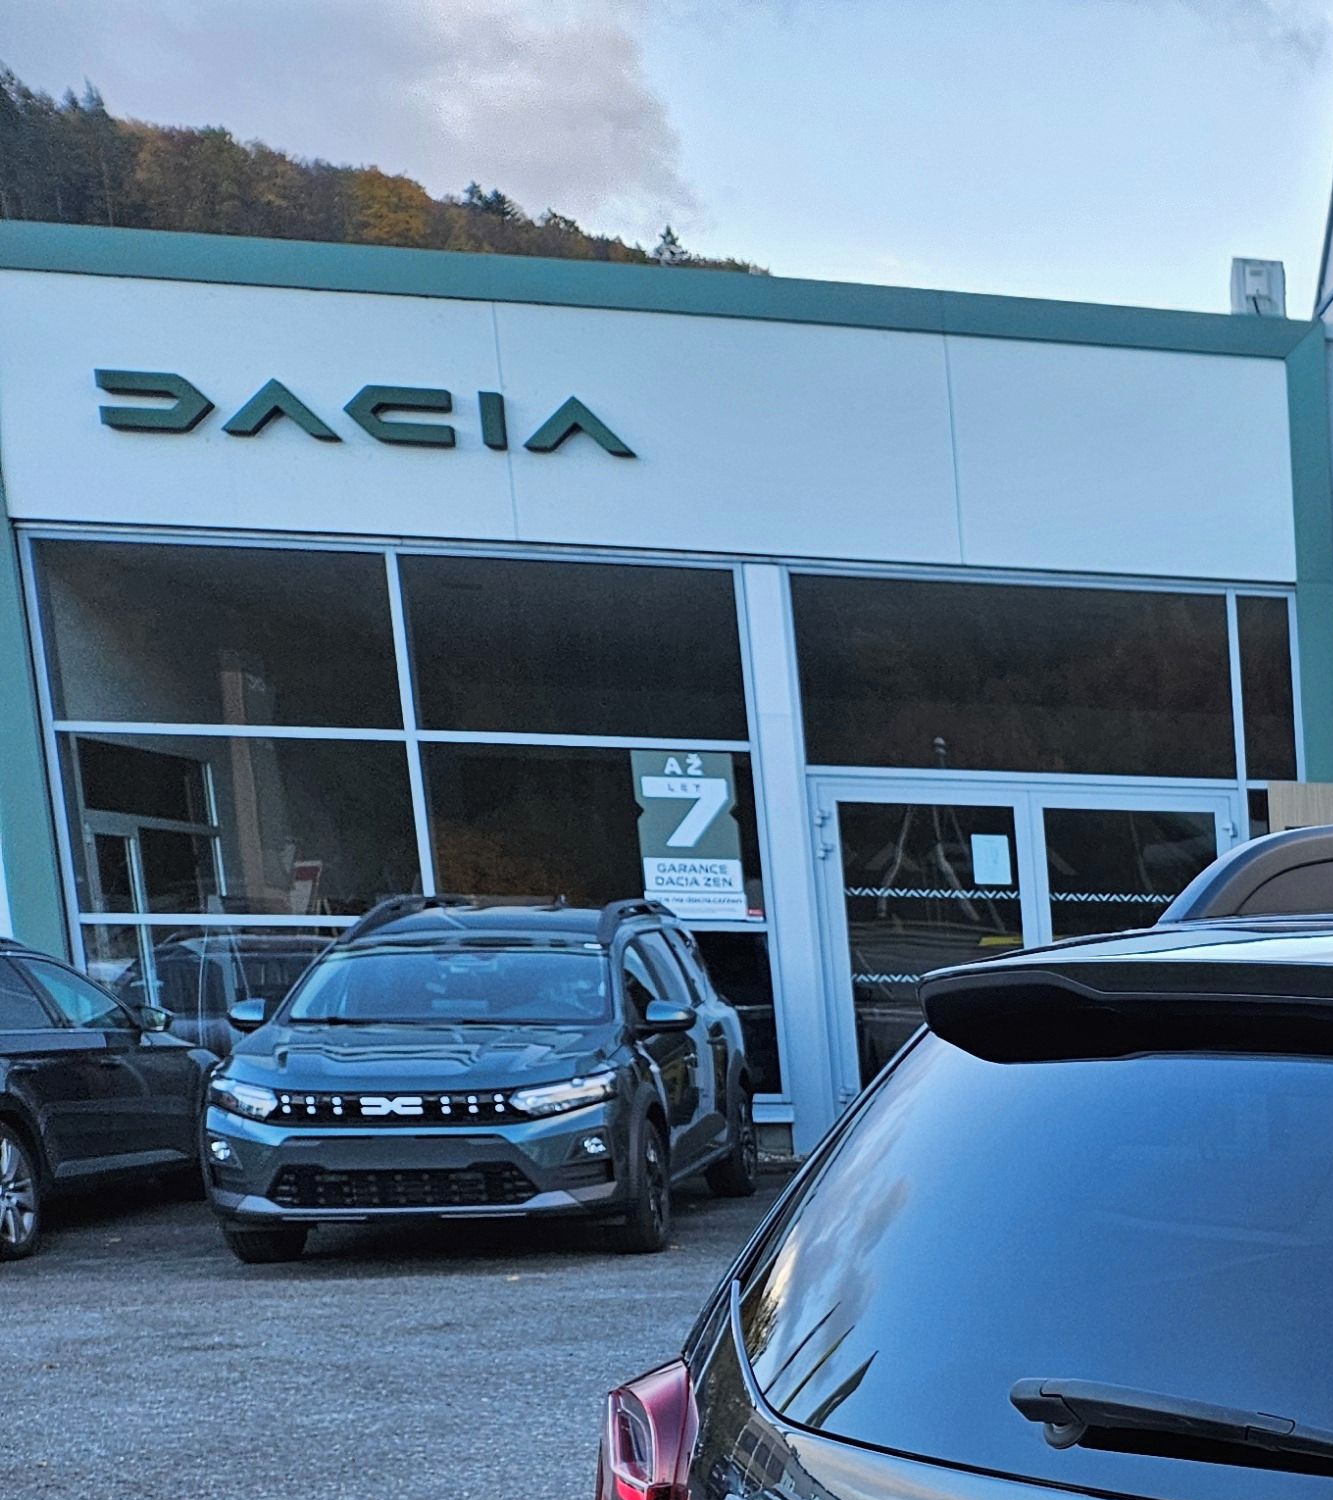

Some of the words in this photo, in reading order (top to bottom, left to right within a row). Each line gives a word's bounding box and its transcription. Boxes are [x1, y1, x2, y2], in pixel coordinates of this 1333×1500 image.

[94, 368, 637, 458] DACIA
[664, 753, 704, 776] AŽ
[667, 783, 702, 793] LET
[641, 776, 728, 847] 7
[656, 863, 728, 875] GARANCE
[655, 876, 700, 887] DACIA
[703, 877, 733, 888] ZEN
